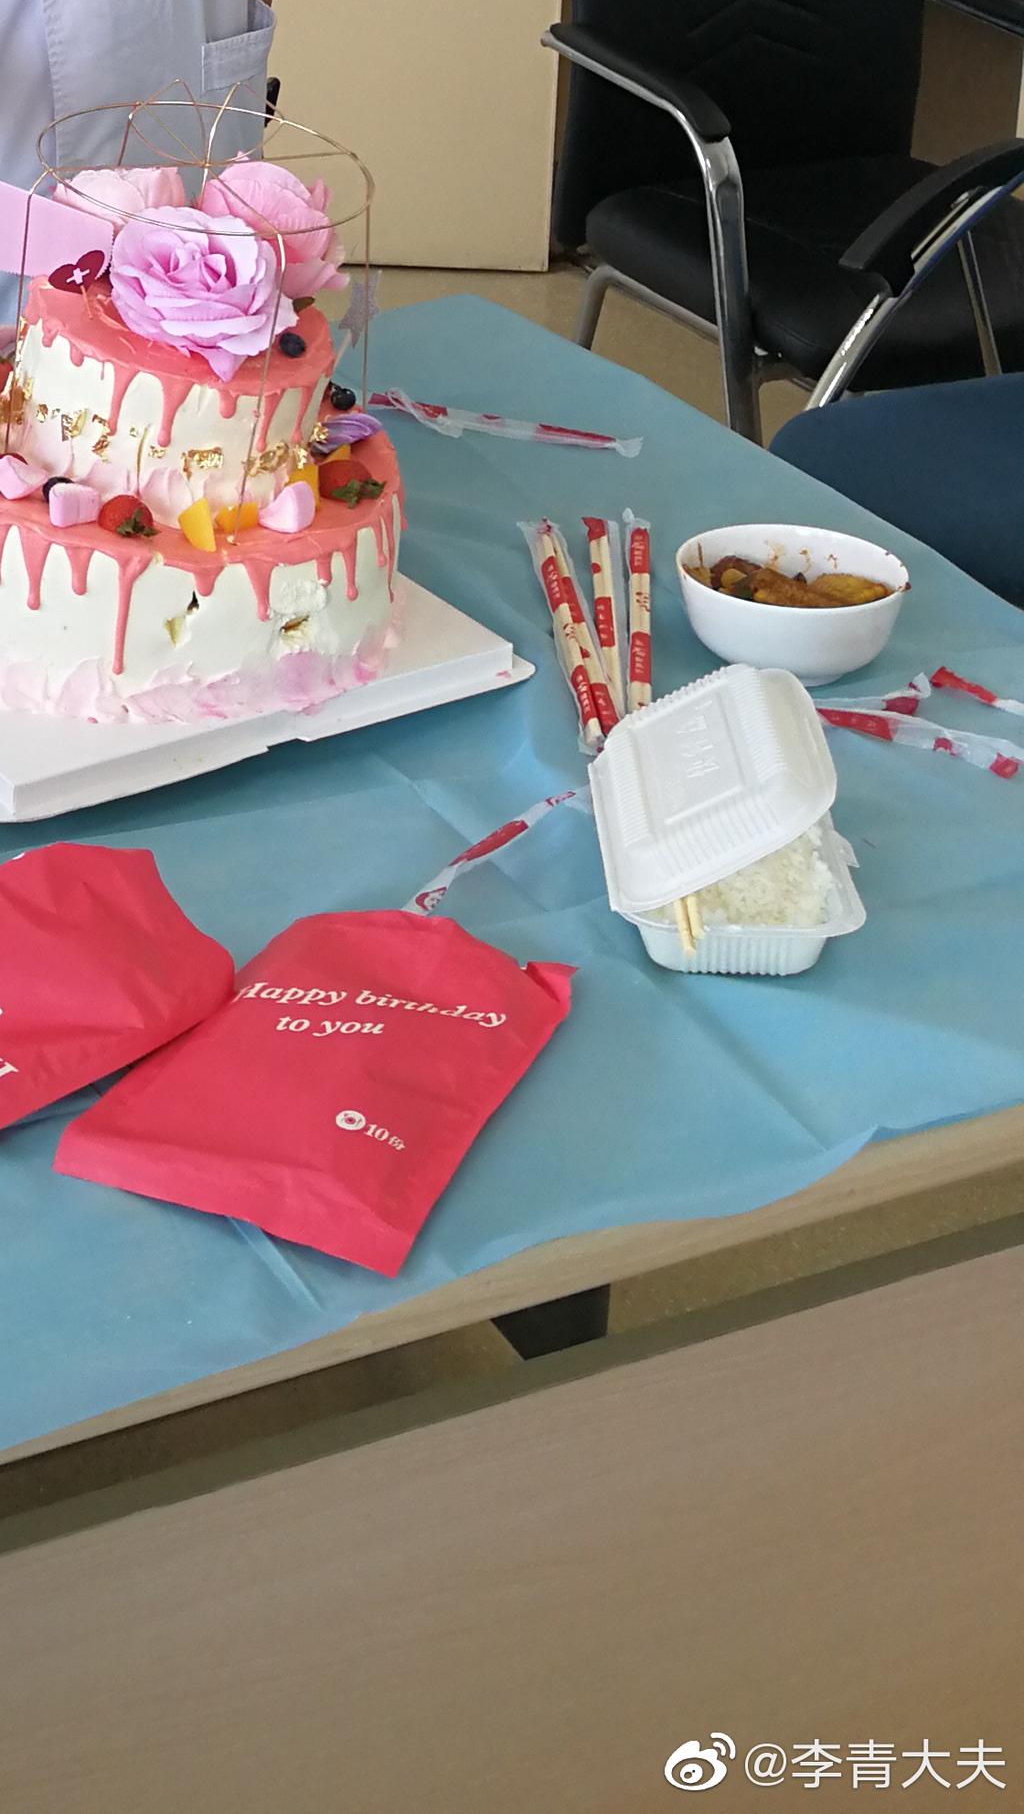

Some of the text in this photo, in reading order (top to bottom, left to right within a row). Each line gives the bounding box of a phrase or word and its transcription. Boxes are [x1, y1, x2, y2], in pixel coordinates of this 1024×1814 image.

[355, 990, 507, 1028] birthday
[276, 1015, 386, 1037] to you
